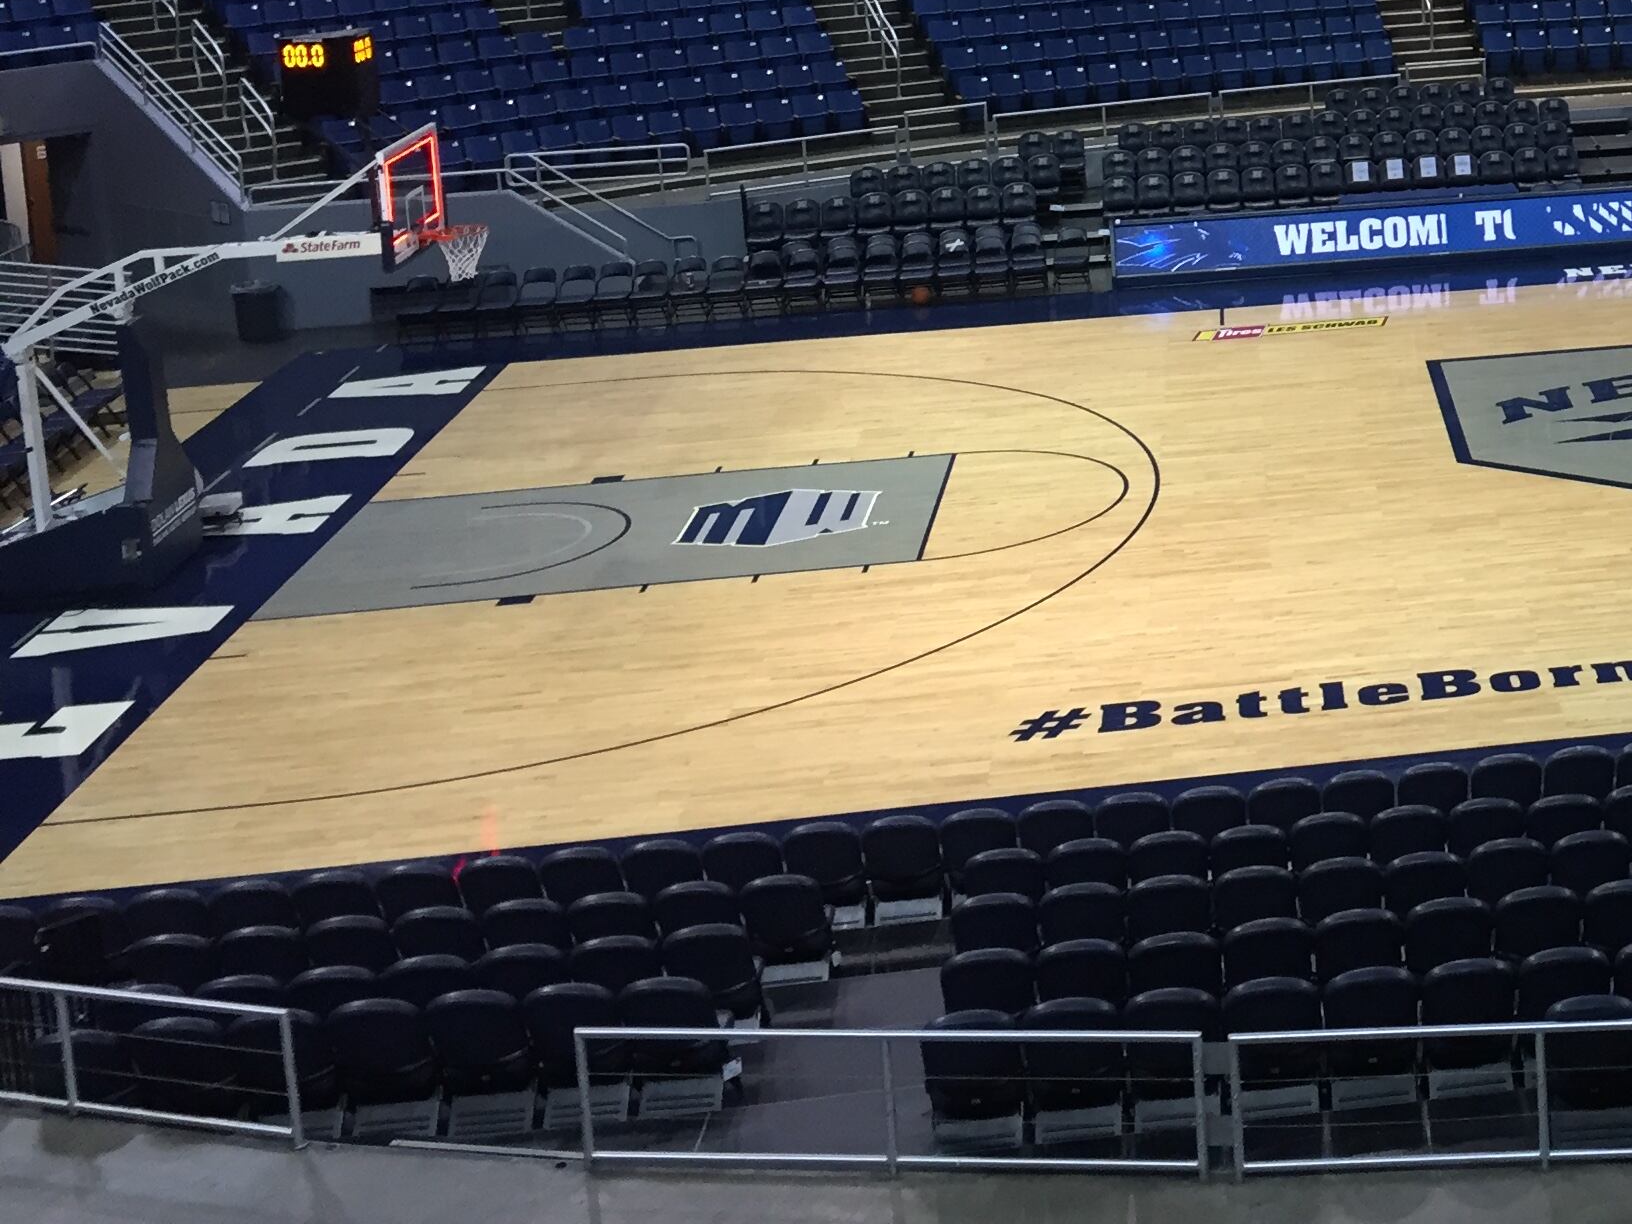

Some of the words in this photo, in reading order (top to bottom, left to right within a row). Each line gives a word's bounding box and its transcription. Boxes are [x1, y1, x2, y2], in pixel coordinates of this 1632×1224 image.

[282, 44, 324, 68] 00.0
[1274, 213, 1449, 257] WELCOM
[89, 251, 220, 315] NevadaWolfPack.com
[1217, 328, 1263, 339] Tires
[1268, 325, 1297, 333] LES
[1301, 318, 1379, 331] SCHWAB
